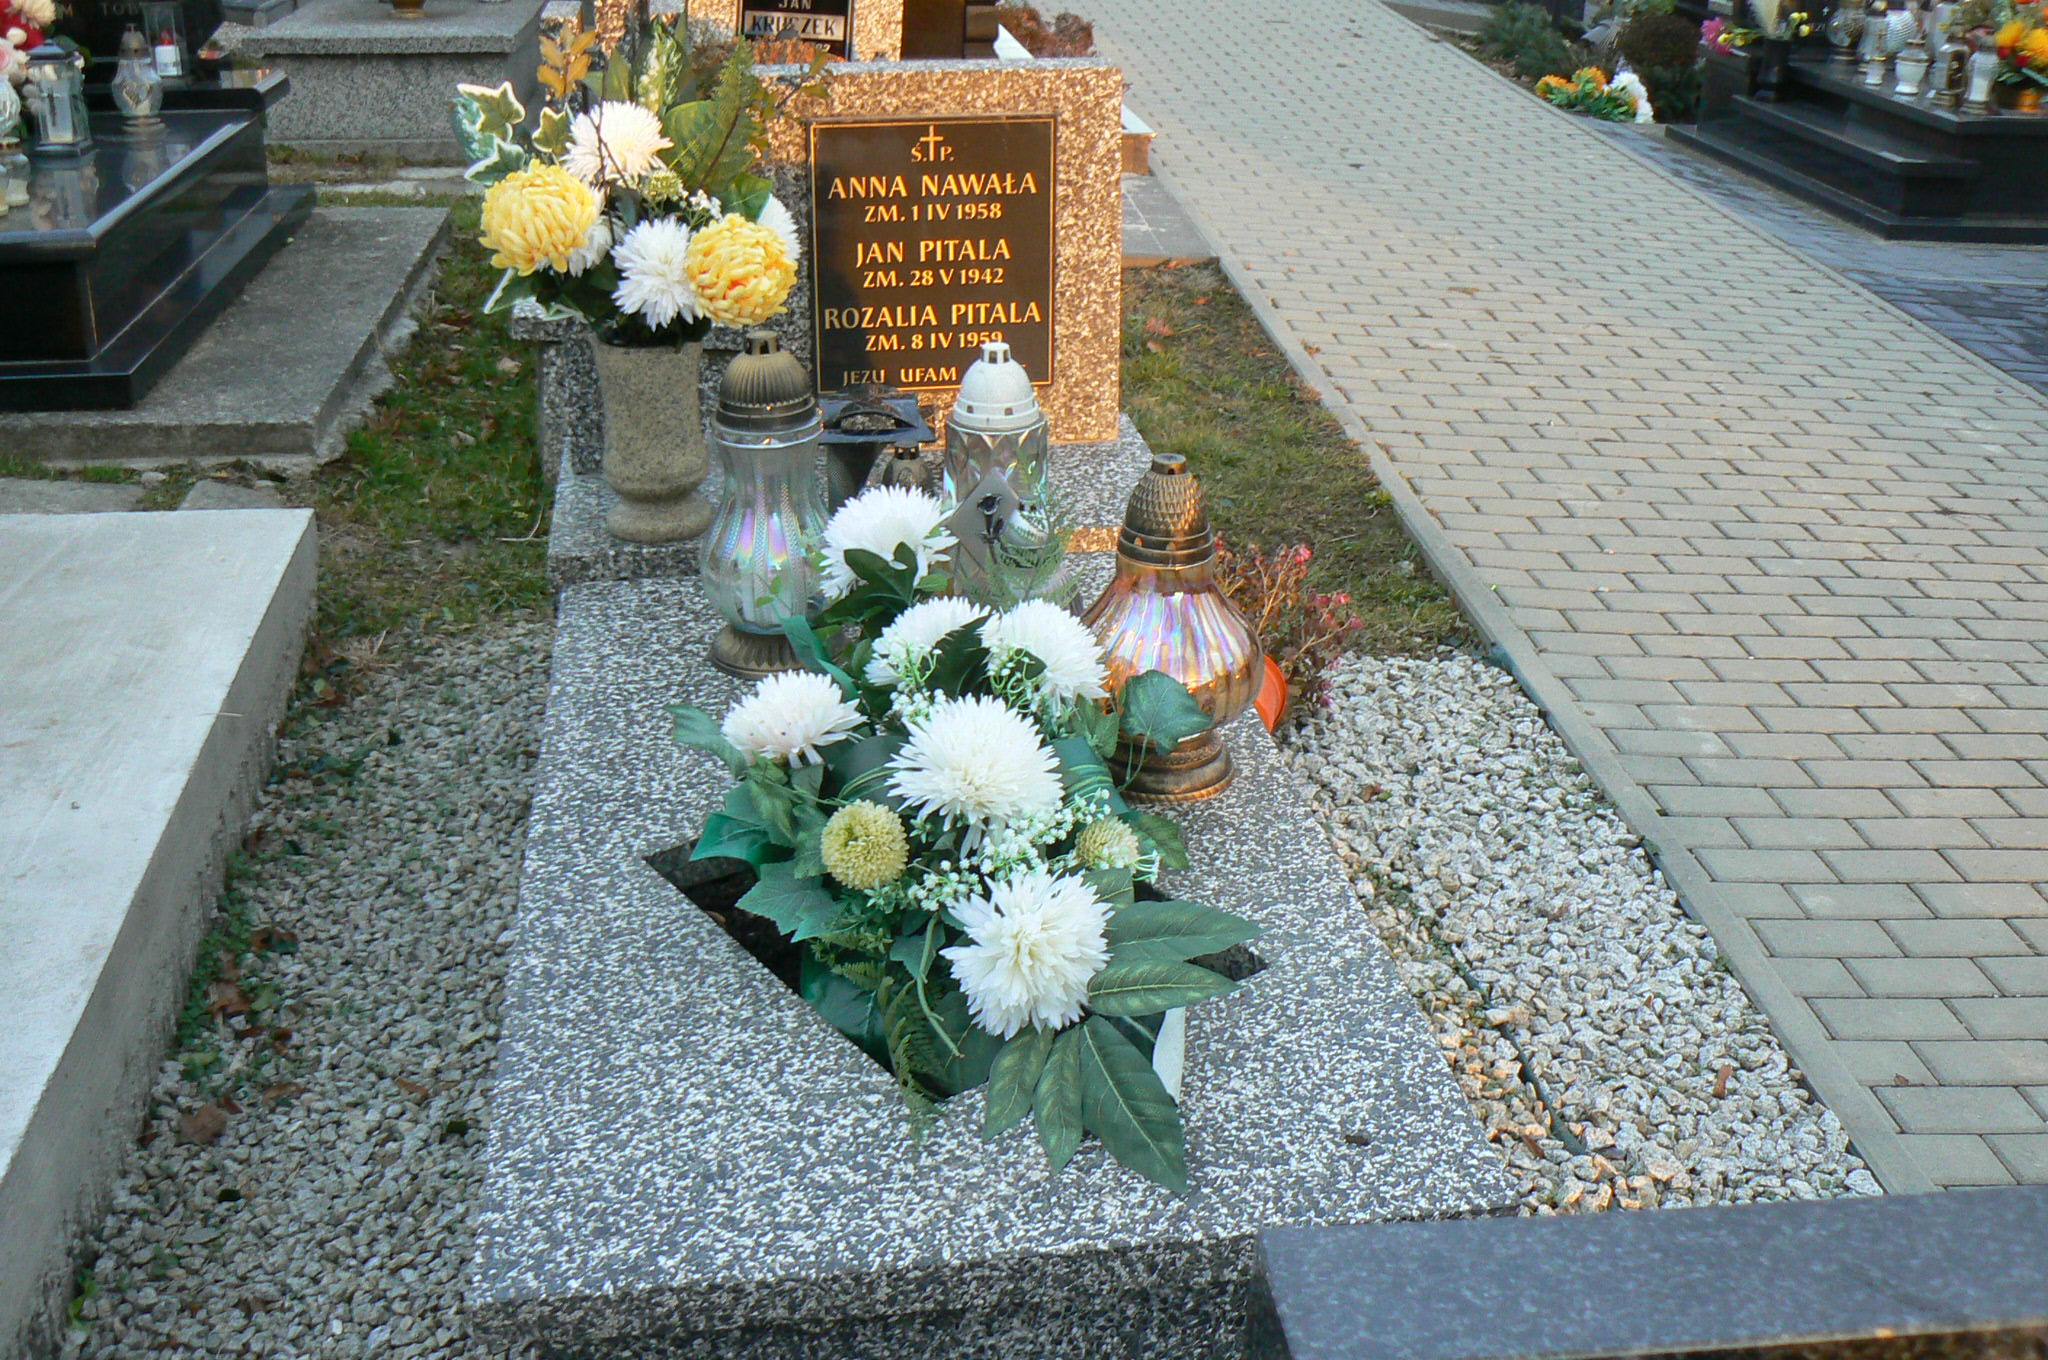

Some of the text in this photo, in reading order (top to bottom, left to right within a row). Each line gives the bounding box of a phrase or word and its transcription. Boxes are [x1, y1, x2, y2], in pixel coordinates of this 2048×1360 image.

[827, 172, 1038, 200] ANNA NAWAŁA
[864, 202, 1003, 223] ZM. 1 IV 1958
[856, 238, 1012, 269] JAN PITALA
[863, 267, 1005, 289] ZM. 28 V 1942
[824, 301, 1043, 330] ROZALIA PITALA
[865, 330, 1004, 352] ZM. 8 IV 1959
[843, 366, 958, 388] JEZU UFAM
